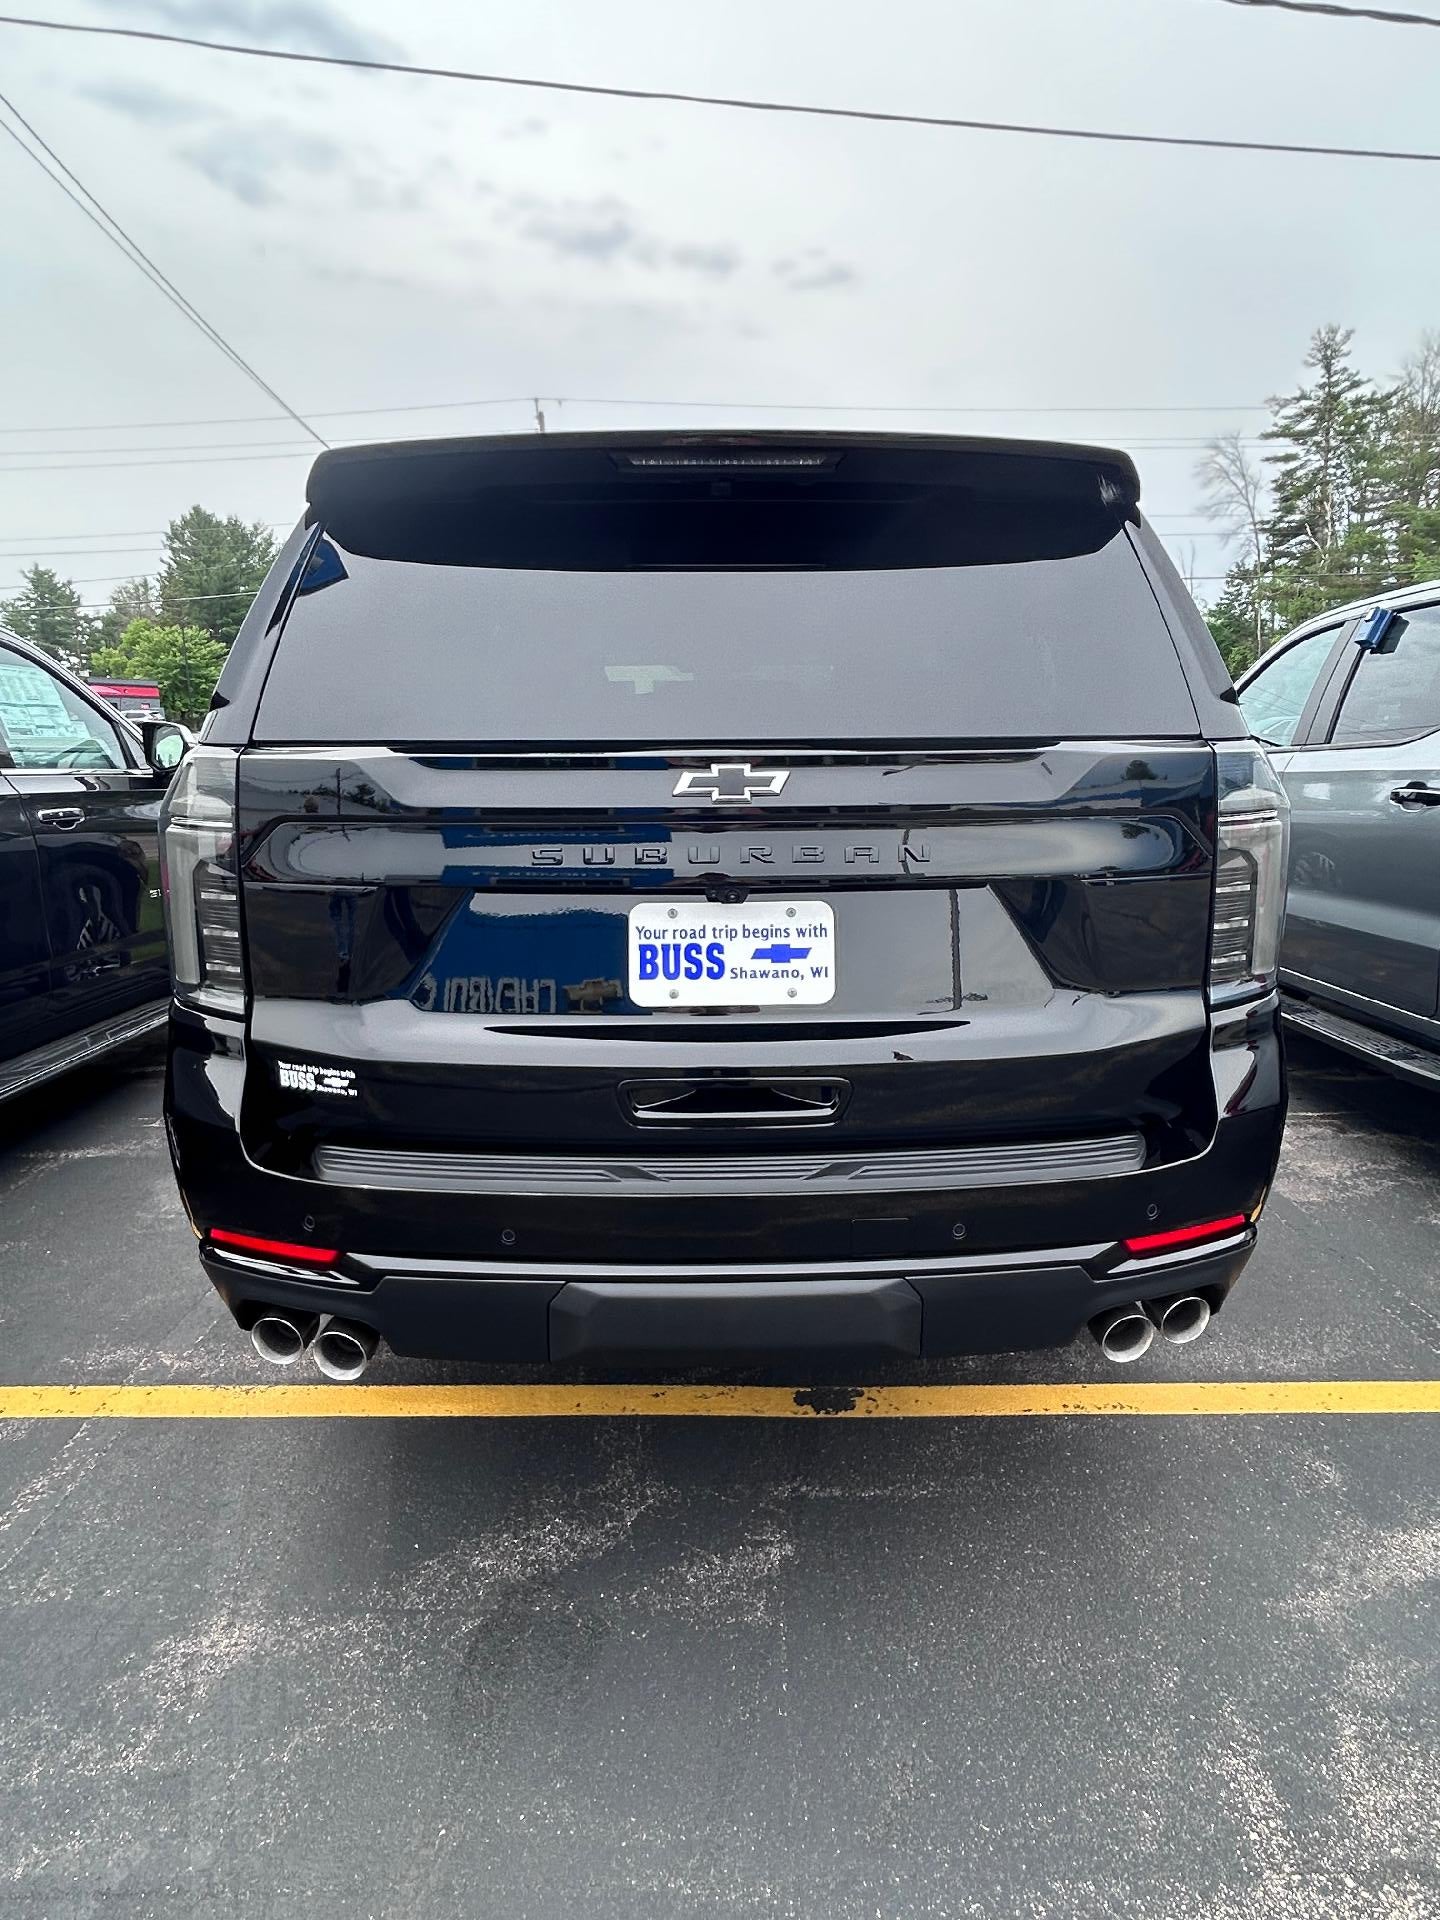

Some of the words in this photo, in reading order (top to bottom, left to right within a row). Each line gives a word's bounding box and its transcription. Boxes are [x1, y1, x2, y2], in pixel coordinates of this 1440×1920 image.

[531, 844, 931, 867] SUBURBAN
[635, 926, 668, 940] Your
[672, 925, 707, 940] road
[712, 924, 738, 941] trip
[742, 924, 791, 941] begins
[796, 923, 828, 938] with
[638, 942, 725, 981] BUSS
[730, 967, 805, 981] Shawano,
[810, 966, 829, 978] WI
[280, 1068, 316, 1091] BUSS
